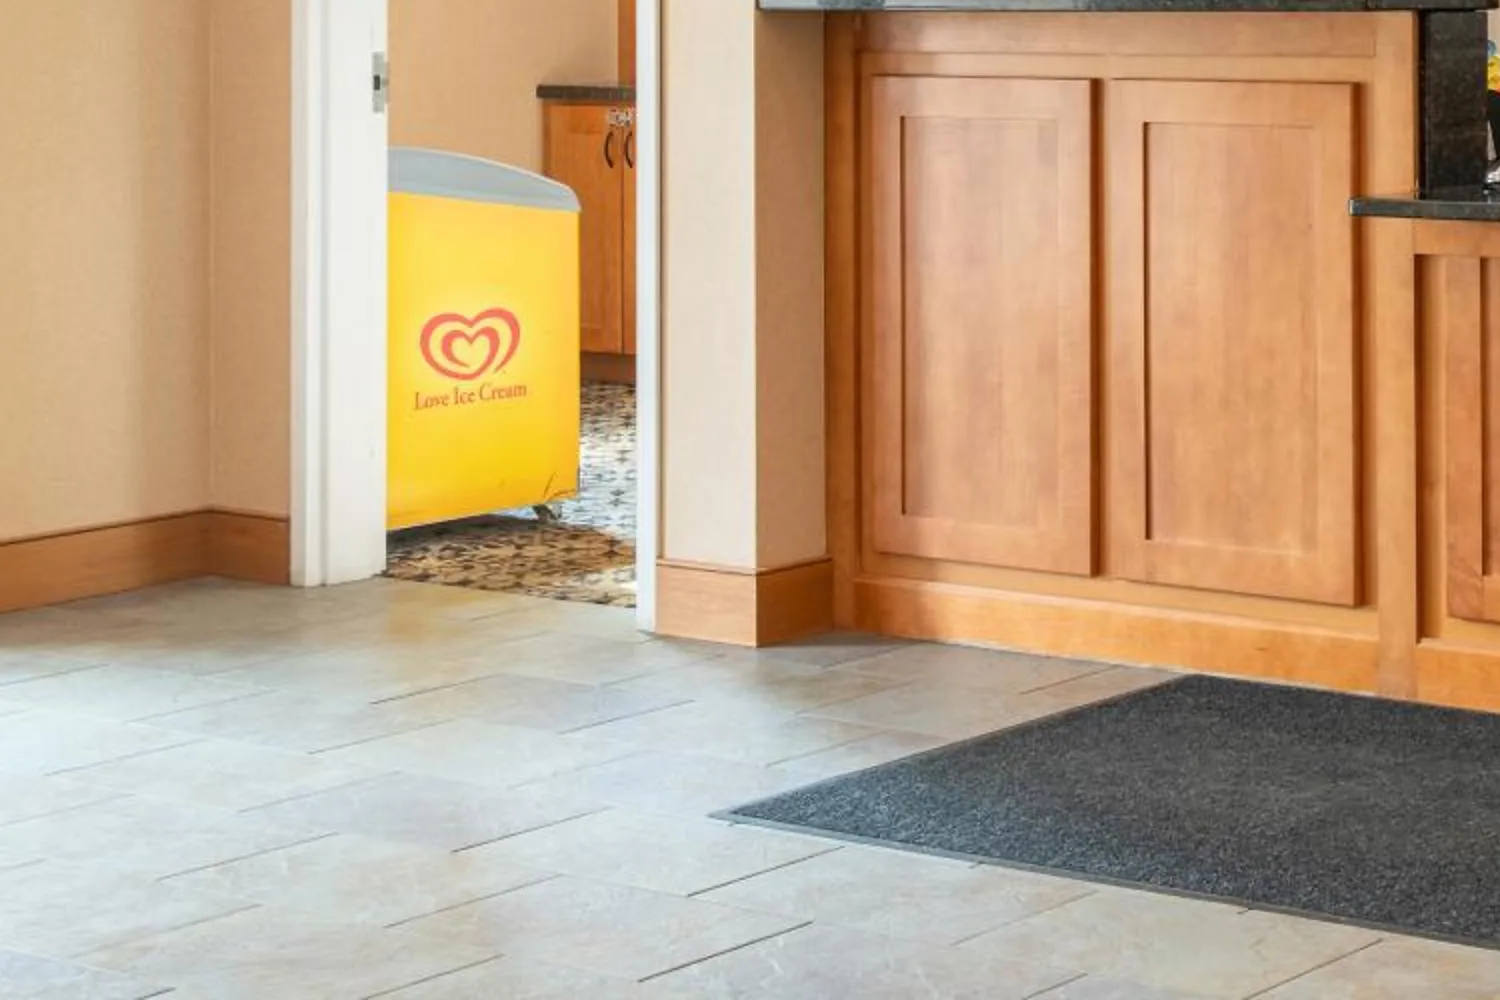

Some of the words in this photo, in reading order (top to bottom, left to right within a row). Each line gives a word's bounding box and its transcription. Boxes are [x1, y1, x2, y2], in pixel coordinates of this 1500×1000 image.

[413, 391, 450, 411] Love
[453, 385, 476, 406] Ice
[479, 381, 527, 401] Cream
